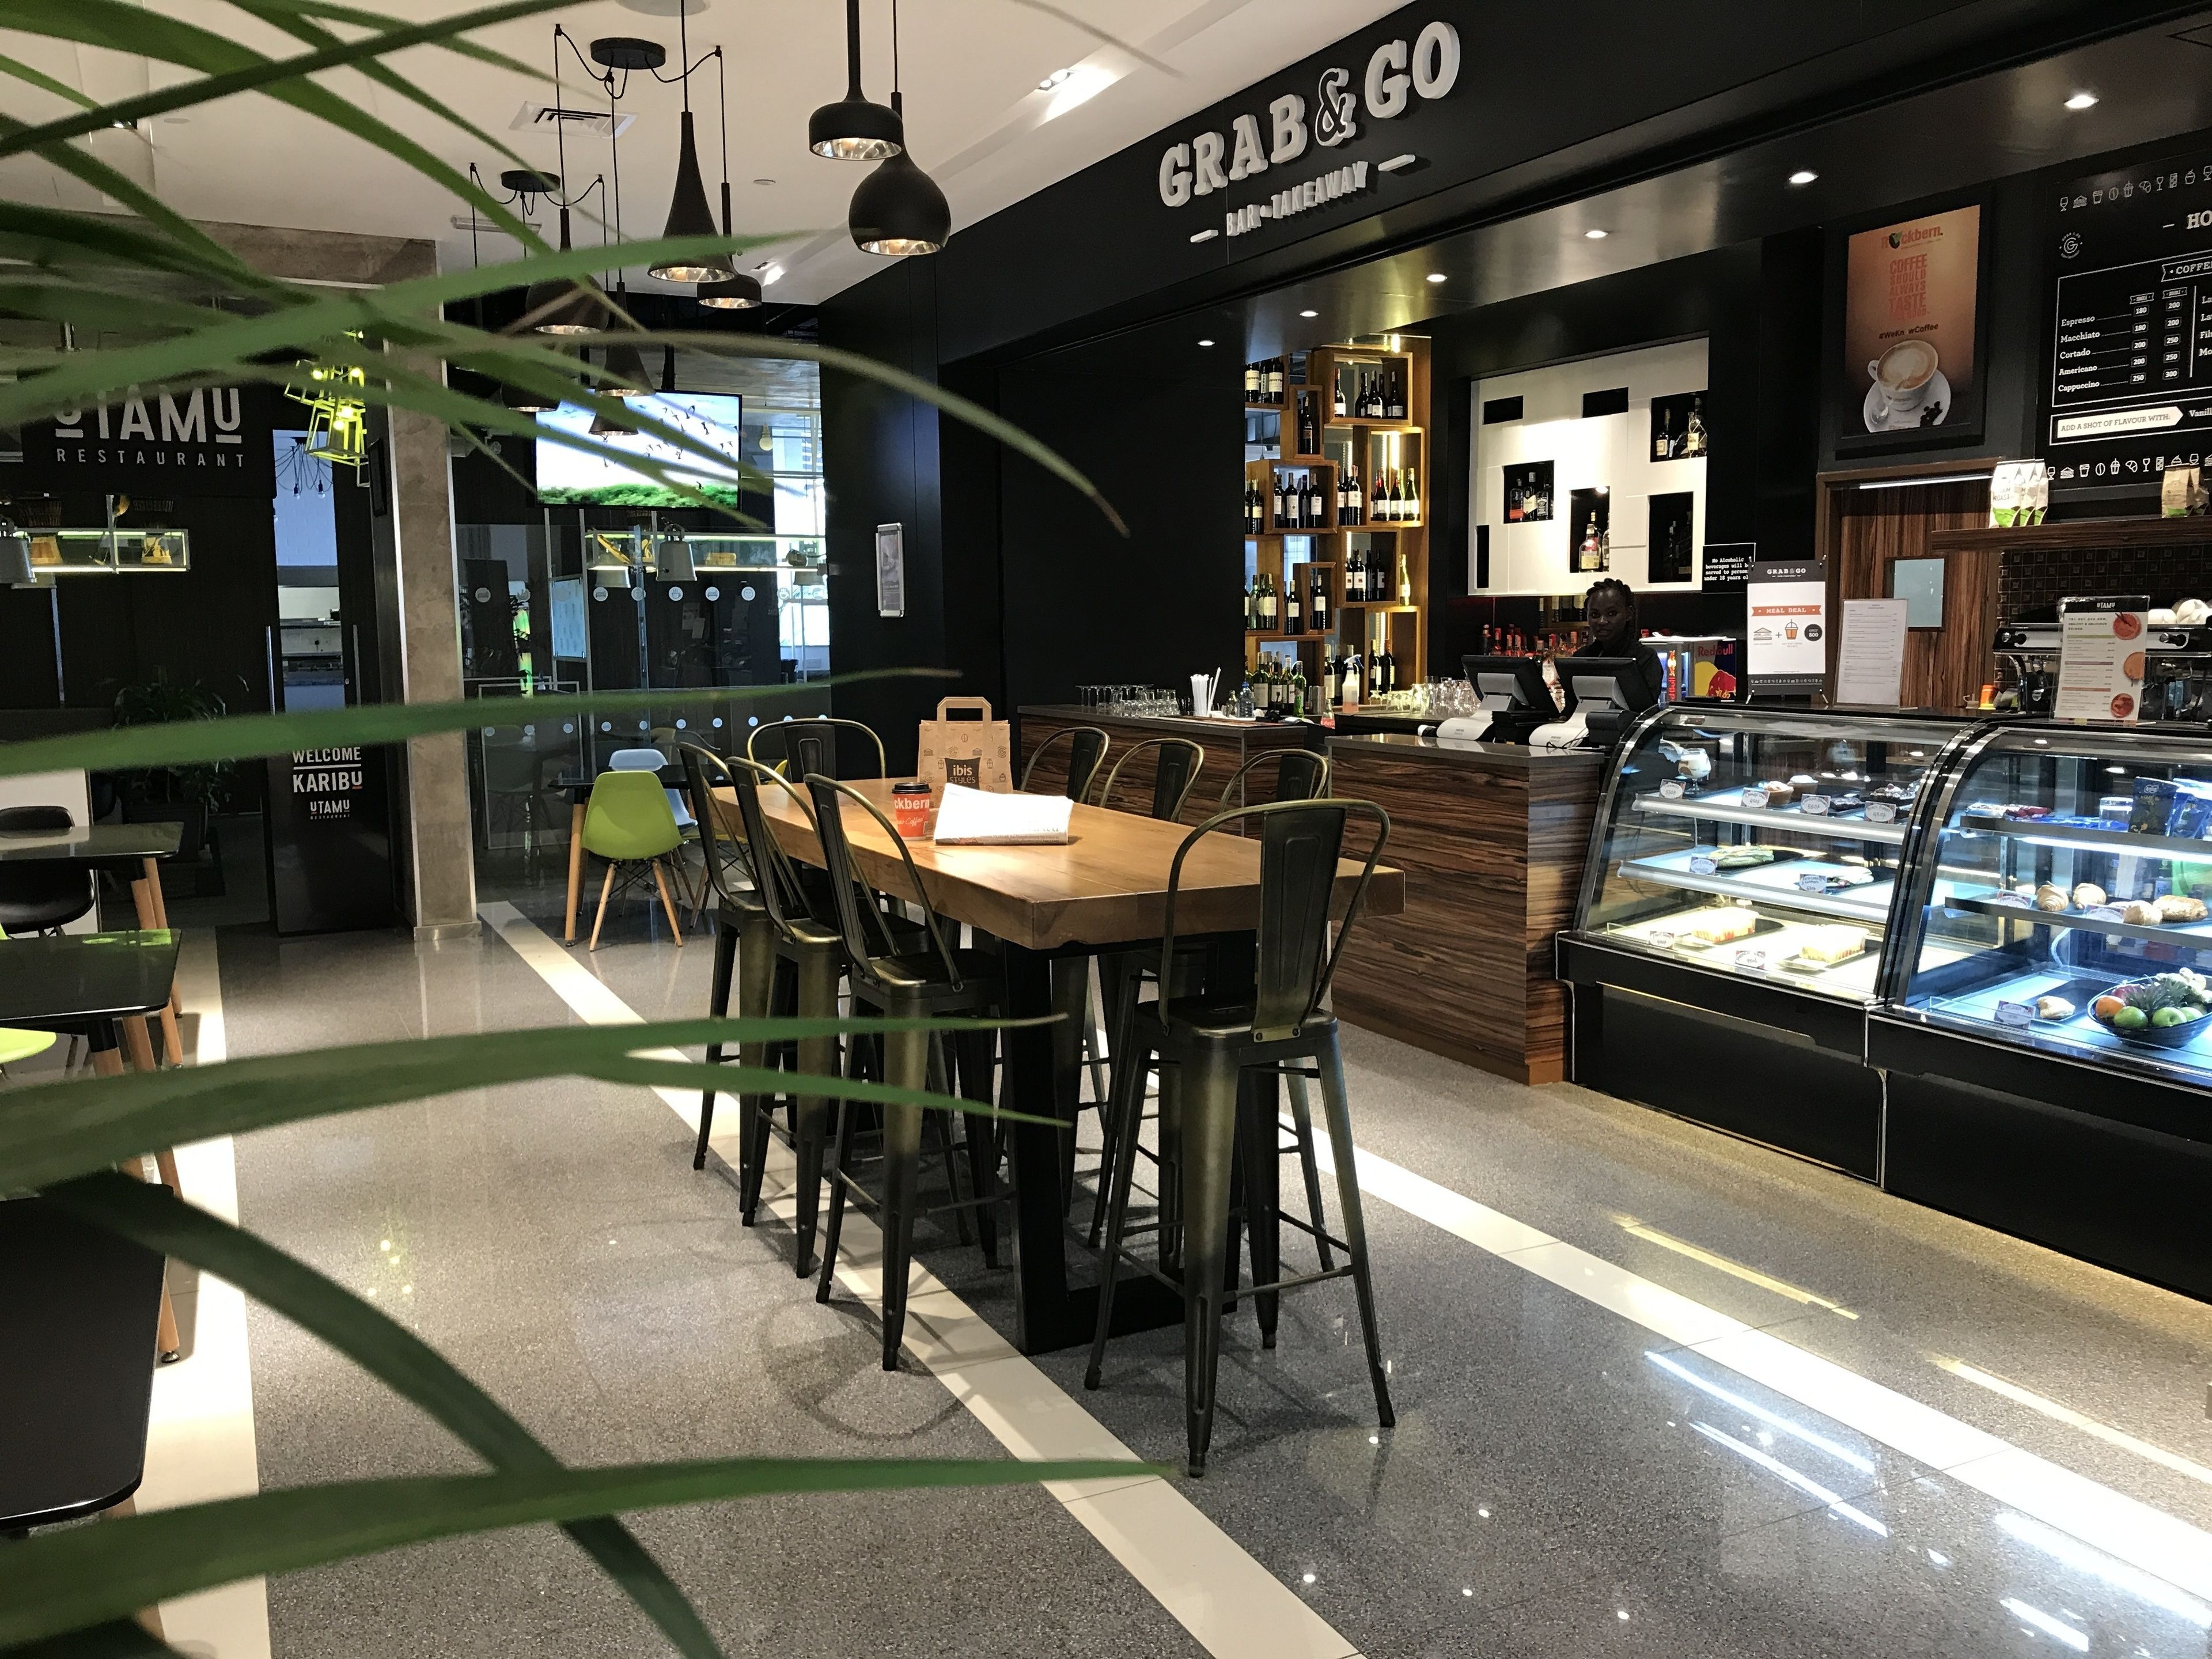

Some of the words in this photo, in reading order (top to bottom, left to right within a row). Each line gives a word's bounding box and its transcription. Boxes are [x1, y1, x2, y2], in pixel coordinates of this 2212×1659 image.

[1889, 253, 1927, 275] COFFEE
[2176, 260, 2212, 275] COFFE
[1890, 268, 1926, 286] SHOULD
[1889, 280, 1926, 297] ALWAYS
[1889, 291, 1926, 312] TASTE
[2061, 315, 2095, 327] Espresso
[2135, 307, 2147, 315] 180
[2060, 331, 2100, 343] Macchiato
[2060, 348, 2090, 359] Cortado
[2134, 341, 2146, 349] 200
[2058, 365, 2098, 376] Americano
[2133, 358, 2145, 366] 200
[2165, 353, 2178, 361] 250
[2058, 381, 2100, 392] Cappuccino
[2084, 421, 2103, 429] SHOT
[2114, 416, 2146, 426] FLAVOUR
[56, 448, 243, 467] RESTAURANT
[293, 747, 361, 763] WELCOME
[953, 764, 972, 776] ibis
[293, 771, 363, 793] KARIBU
[310, 800, 350, 815] UTAMU
